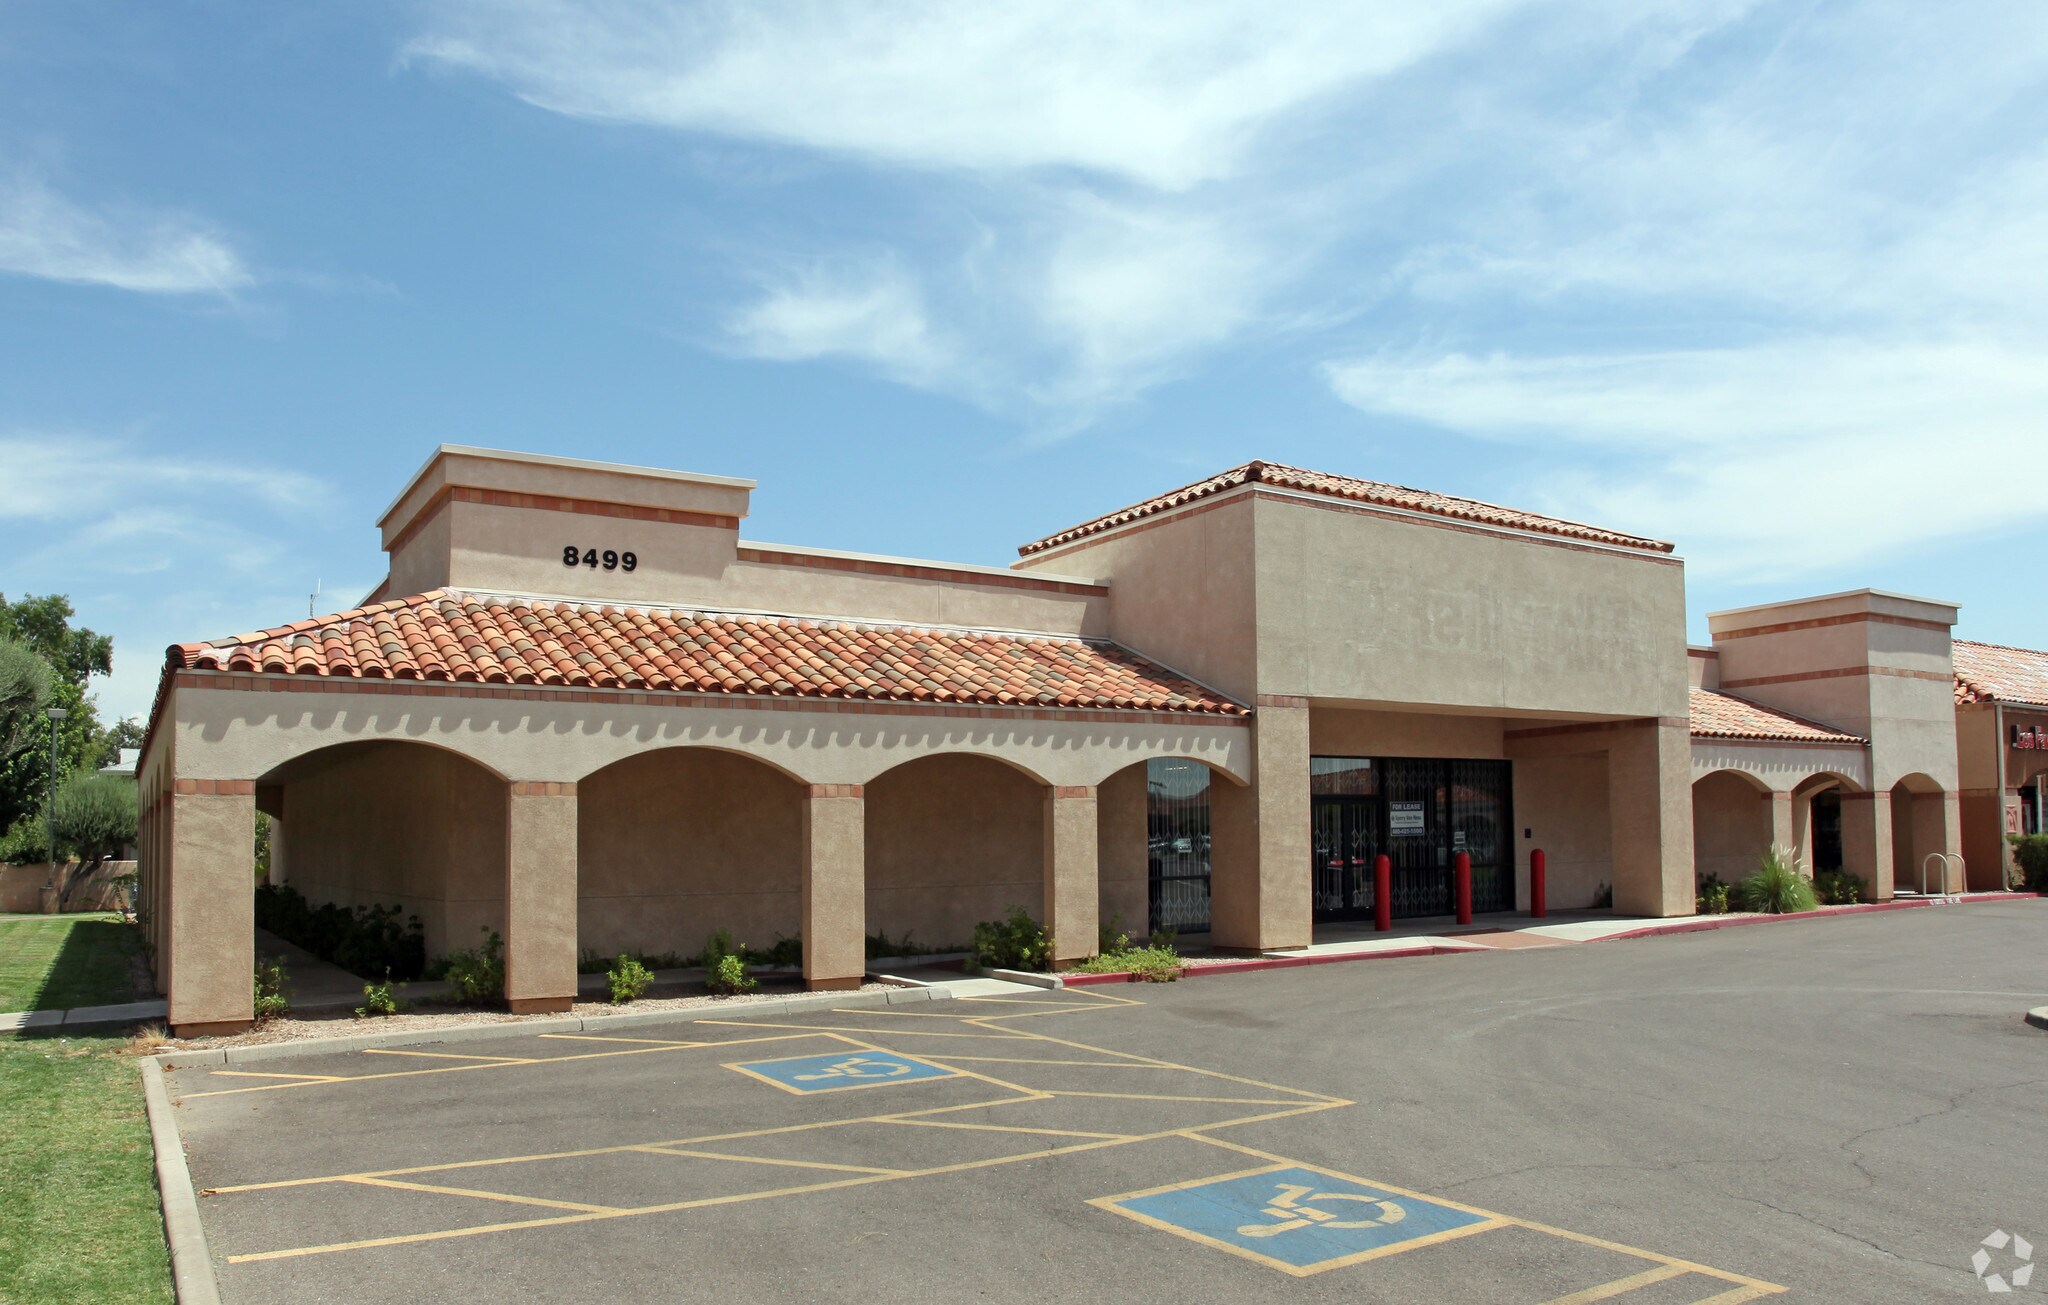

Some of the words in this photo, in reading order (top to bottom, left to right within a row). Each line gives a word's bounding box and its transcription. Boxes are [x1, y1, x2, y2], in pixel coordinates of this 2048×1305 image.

[563, 546, 637, 571] 8499
[2011, 724, 2035, 749] Los
[2035, 725, 2048, 750] Fa
